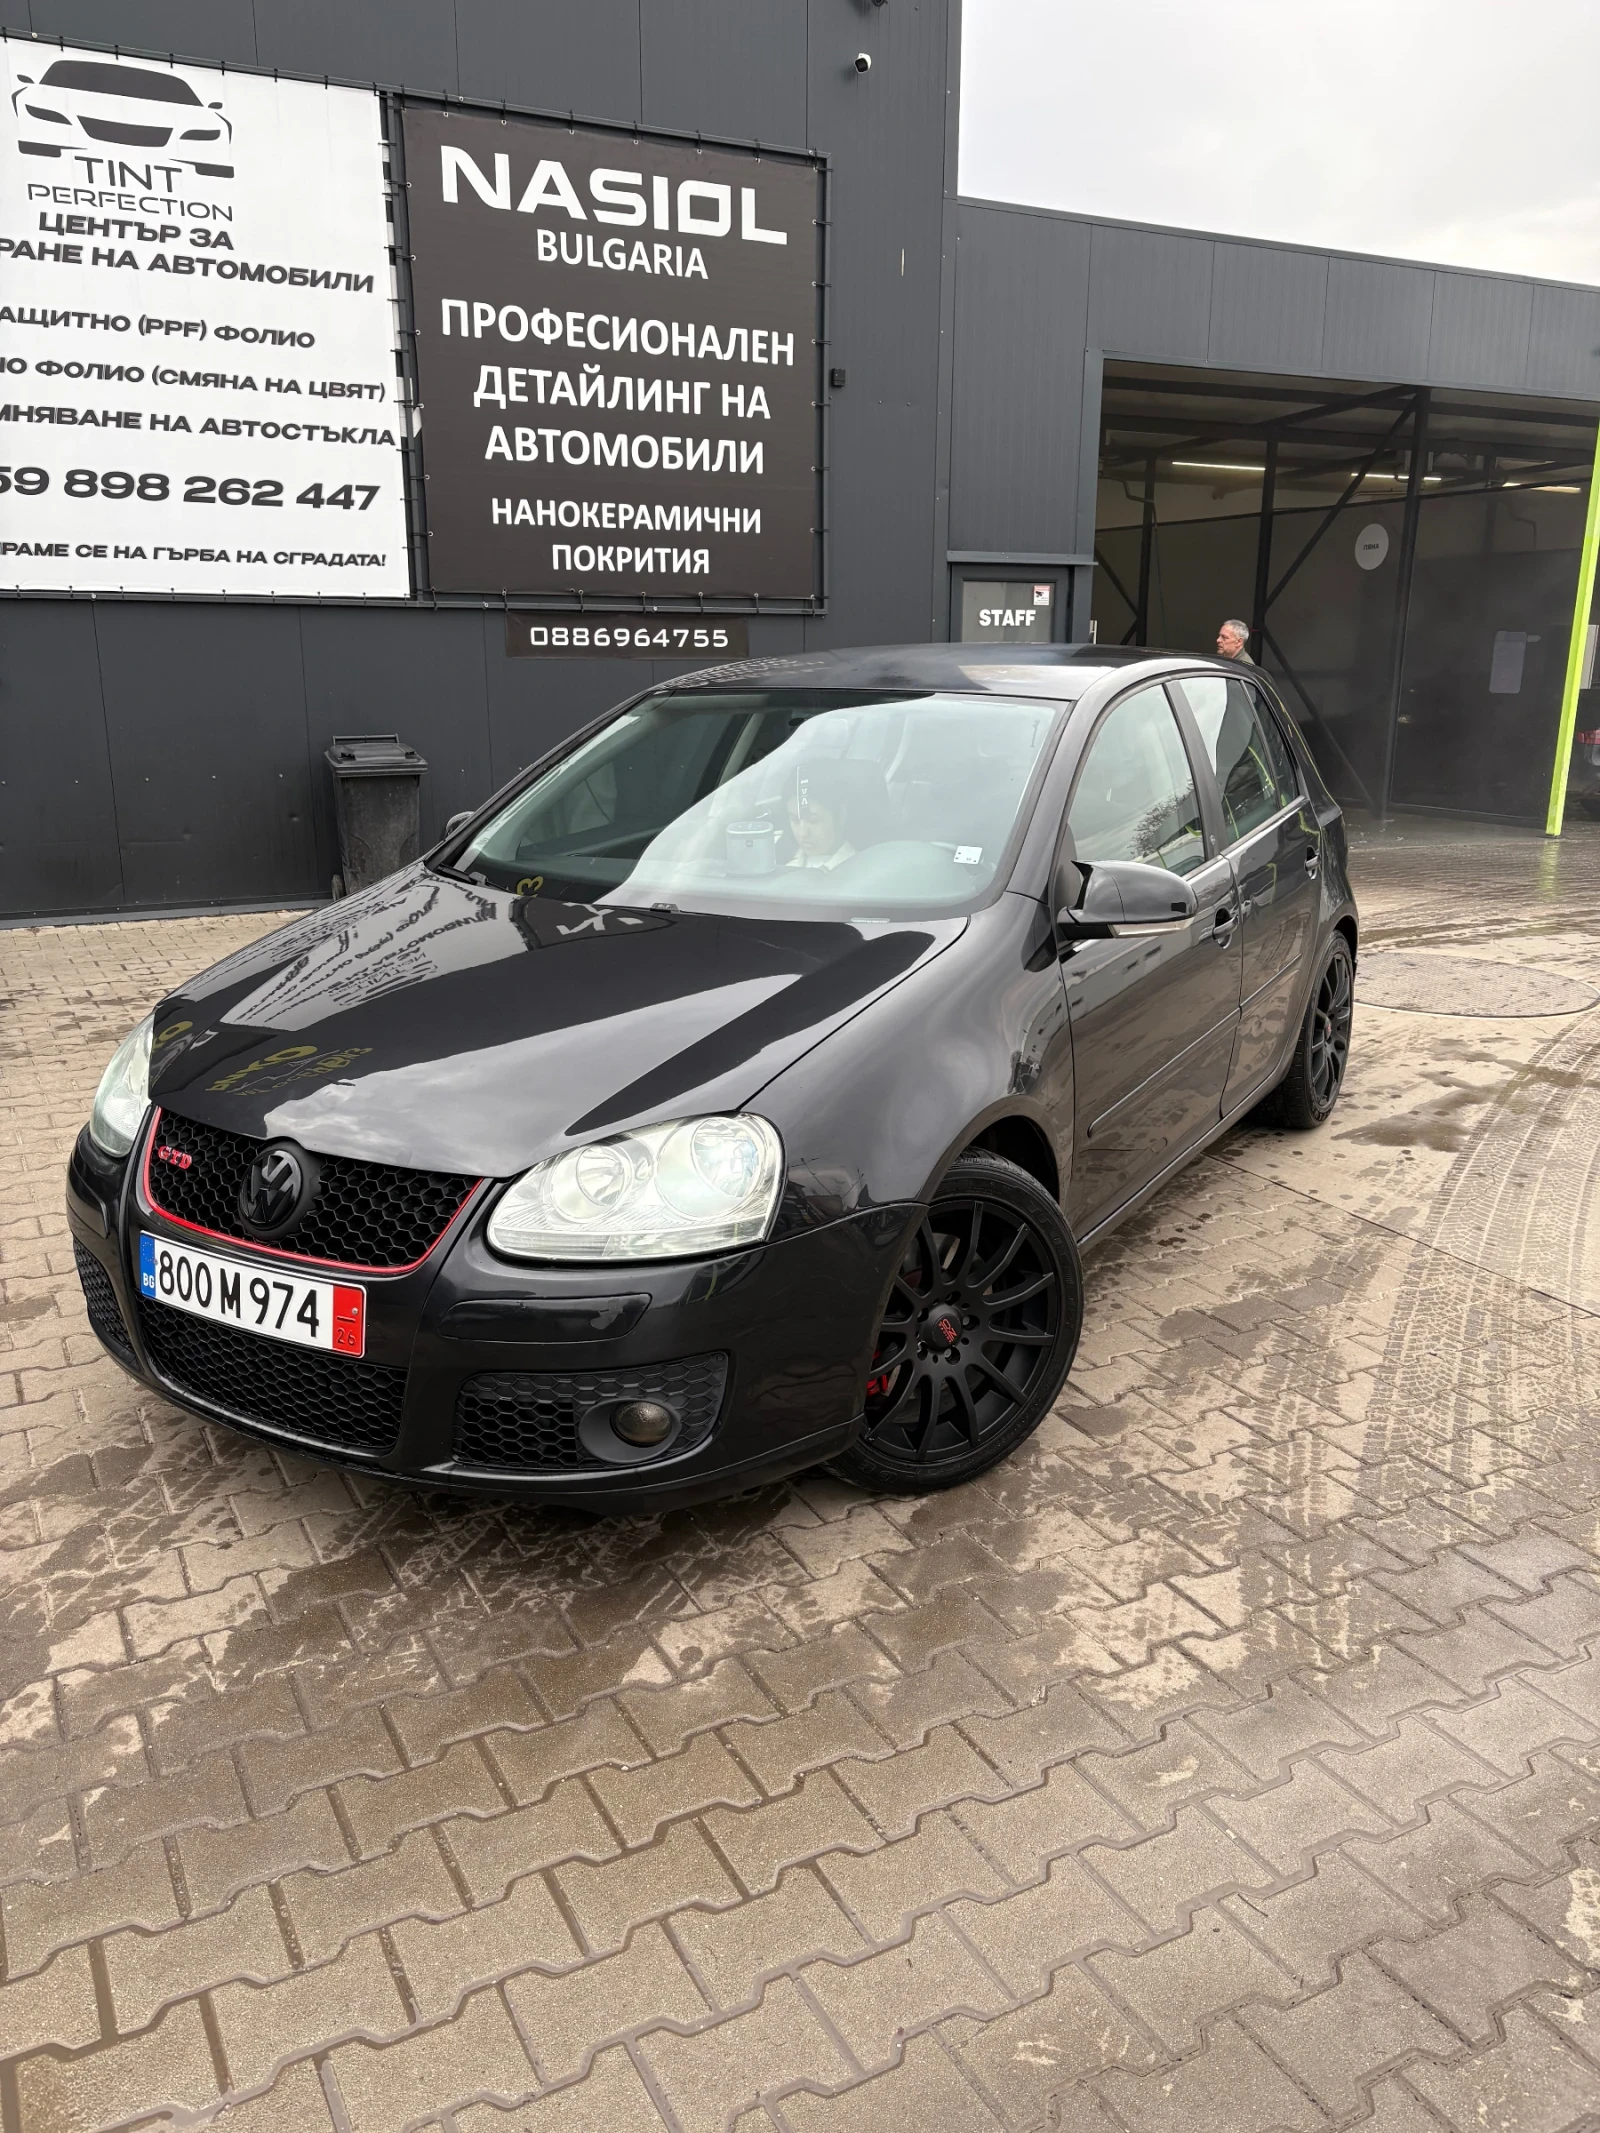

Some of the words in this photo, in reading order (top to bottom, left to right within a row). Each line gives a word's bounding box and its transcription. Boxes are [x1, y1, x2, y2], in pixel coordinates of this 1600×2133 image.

[75, 156, 182, 192] TINT
[28, 184, 232, 221] PERFECTION
[441, 145, 787, 245] NASIOL
[39, 212, 181, 243] ЦЕНТЪР
[190, 228, 234, 250] ЗА
[92, 247, 139, 269] НА
[147, 254, 373, 293] АВТОМОБИЛИ
[537, 229, 708, 279] BULGARIA
[0, 307, 130, 331] АЩИТНО
[139, 315, 206, 341] (PPF)
[214, 326, 315, 348] ФОЛИО
[442, 299, 793, 365] ПРОФЕСИОНАЛЕН
[35, 361, 144, 382] ФОЛИО
[152, 366, 257, 390] (СМЯНА
[265, 378, 301, 394] НА
[309, 381, 385, 402] ЦВЯТ)
[474, 363, 710, 414] ДЕТАЙЛИНГ
[722, 384, 770, 419] НА
[150, 414, 192, 432] НА
[199, 418, 395, 445] АВТОСТЪКЛА
[485, 426, 763, 474] АВТОМОБИЛИ
[64, 469, 169, 501] 898
[183, 476, 283, 507] 262
[296, 483, 380, 510] 447
[492, 498, 760, 533] НАНОКЕРАМИЧНИ
[0, 542, 69, 556] РАМЕ
[76, 545, 107, 558] СЕ
[114, 546, 147, 559] НА
[153, 547, 230, 562] ГЪРБА
[237, 551, 267, 563] НА
[274, 552, 386, 567] СГРАДАТА!
[553, 545, 709, 573] ПОКРИТИЯ
[979, 609, 1036, 626] STAFF
[531, 627, 728, 647] 0886964755
[158, 1145, 192, 1170] GTD
[142, 1272, 155, 1289] BG
[159, 1250, 212, 1308] 800
[220, 1267, 241, 1319] M
[250, 1277, 319, 1337] 974
[337, 1327, 356, 1346] 26
